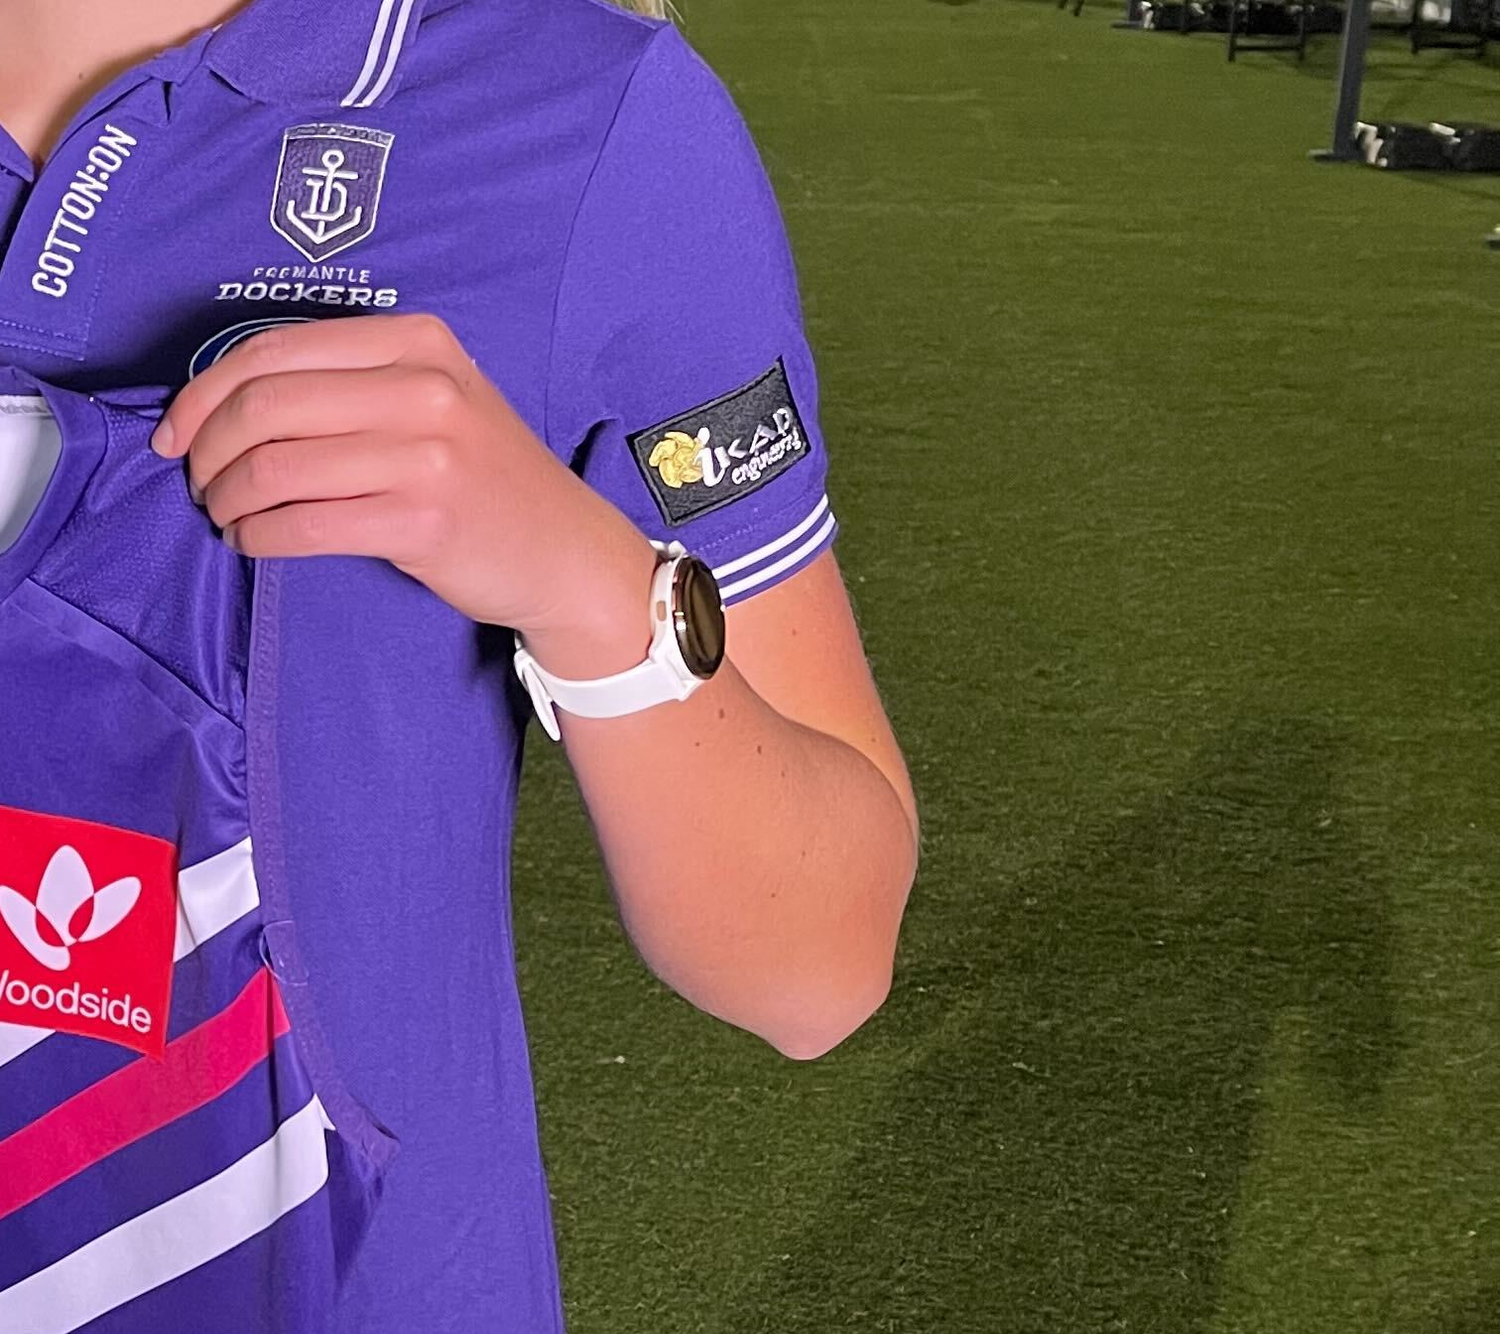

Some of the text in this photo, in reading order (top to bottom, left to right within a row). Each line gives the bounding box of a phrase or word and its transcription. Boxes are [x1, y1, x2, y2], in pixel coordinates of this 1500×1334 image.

[32, 124, 137, 299] COTTON:ON
[253, 265, 371, 284] FREMANTLE
[214, 281, 399, 308] DOCKERS
